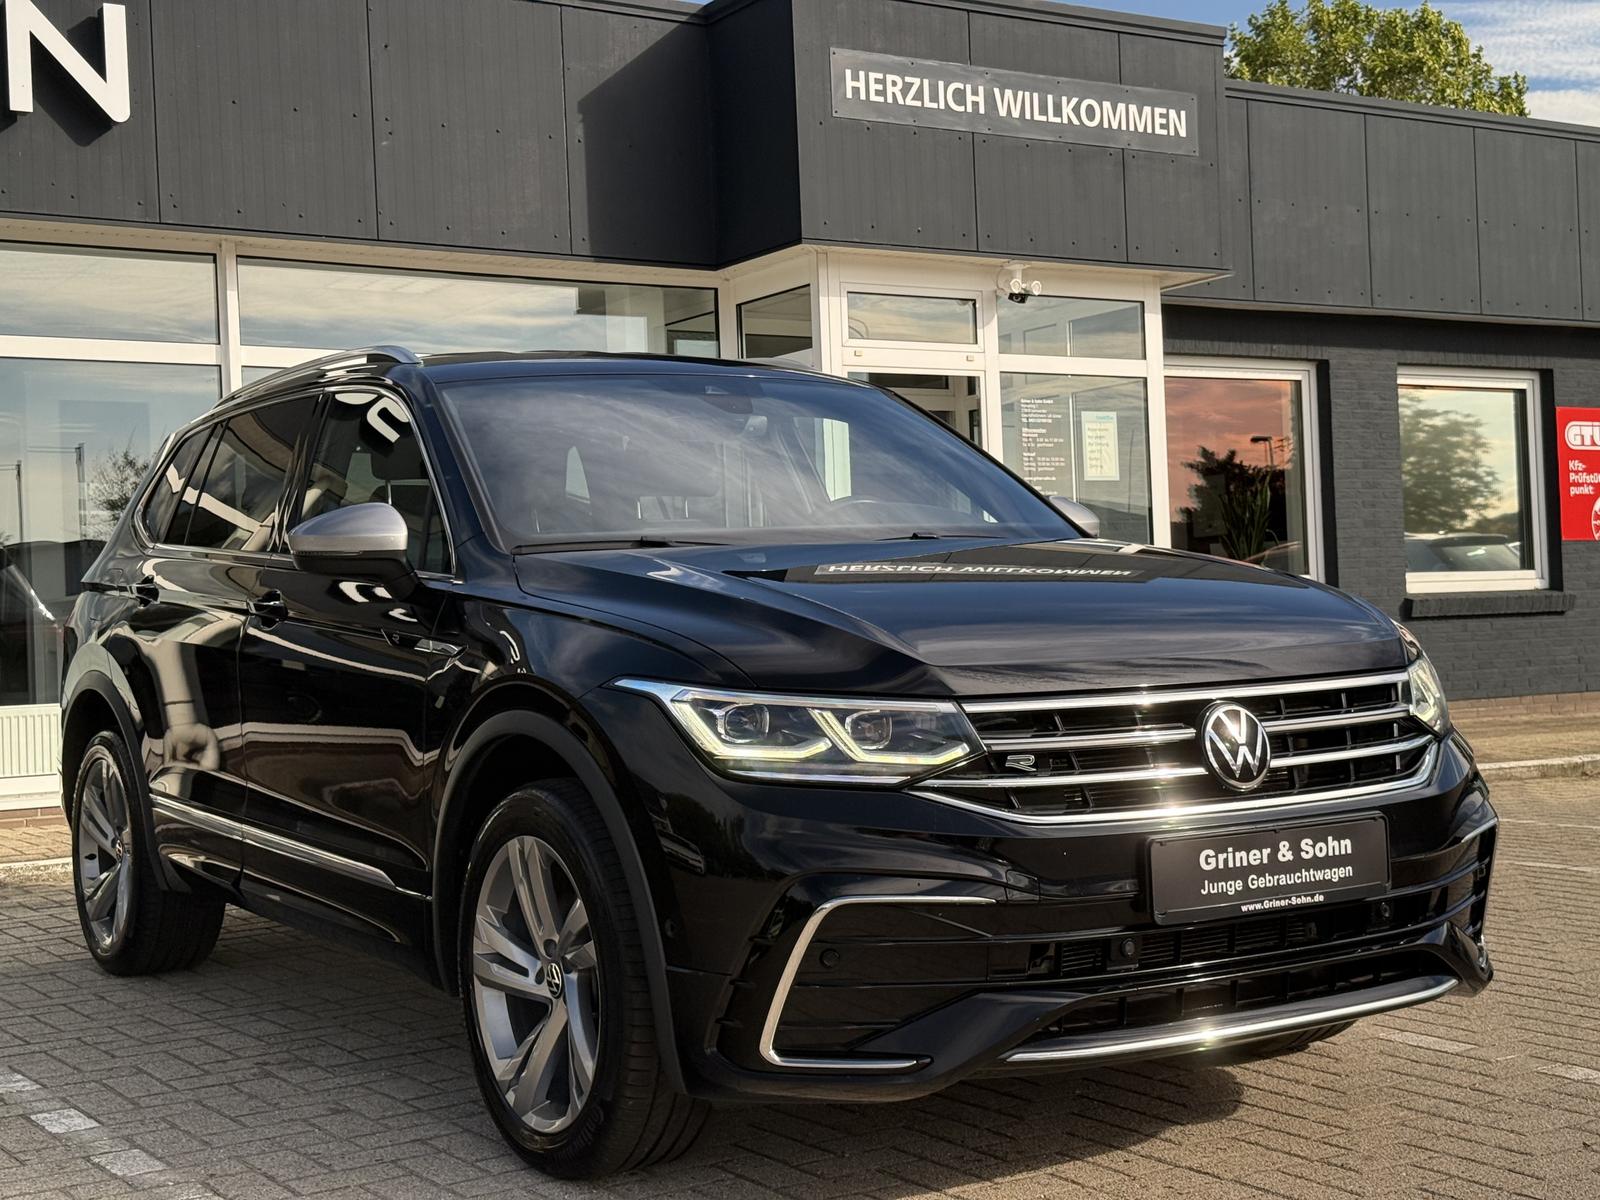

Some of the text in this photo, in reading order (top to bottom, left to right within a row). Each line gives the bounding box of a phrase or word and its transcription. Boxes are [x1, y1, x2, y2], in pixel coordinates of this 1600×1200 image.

[5, 0, 131, 123] N
[844, 68, 1188, 138] HERZLICH WILLKOMMEN
[1568, 459, 1586, 471] Kfz-
[1569, 472, 1600, 483] Prüfstü
[1570, 484, 1595, 497] punkt
[1205, 704, 1271, 788] VW
[1199, 835, 1353, 871] Griner & Sohn
[1200, 865, 1354, 896] Junge Gebrauchtwagen
[1240, 892, 1325, 913] www.Griner-Sohn.de
